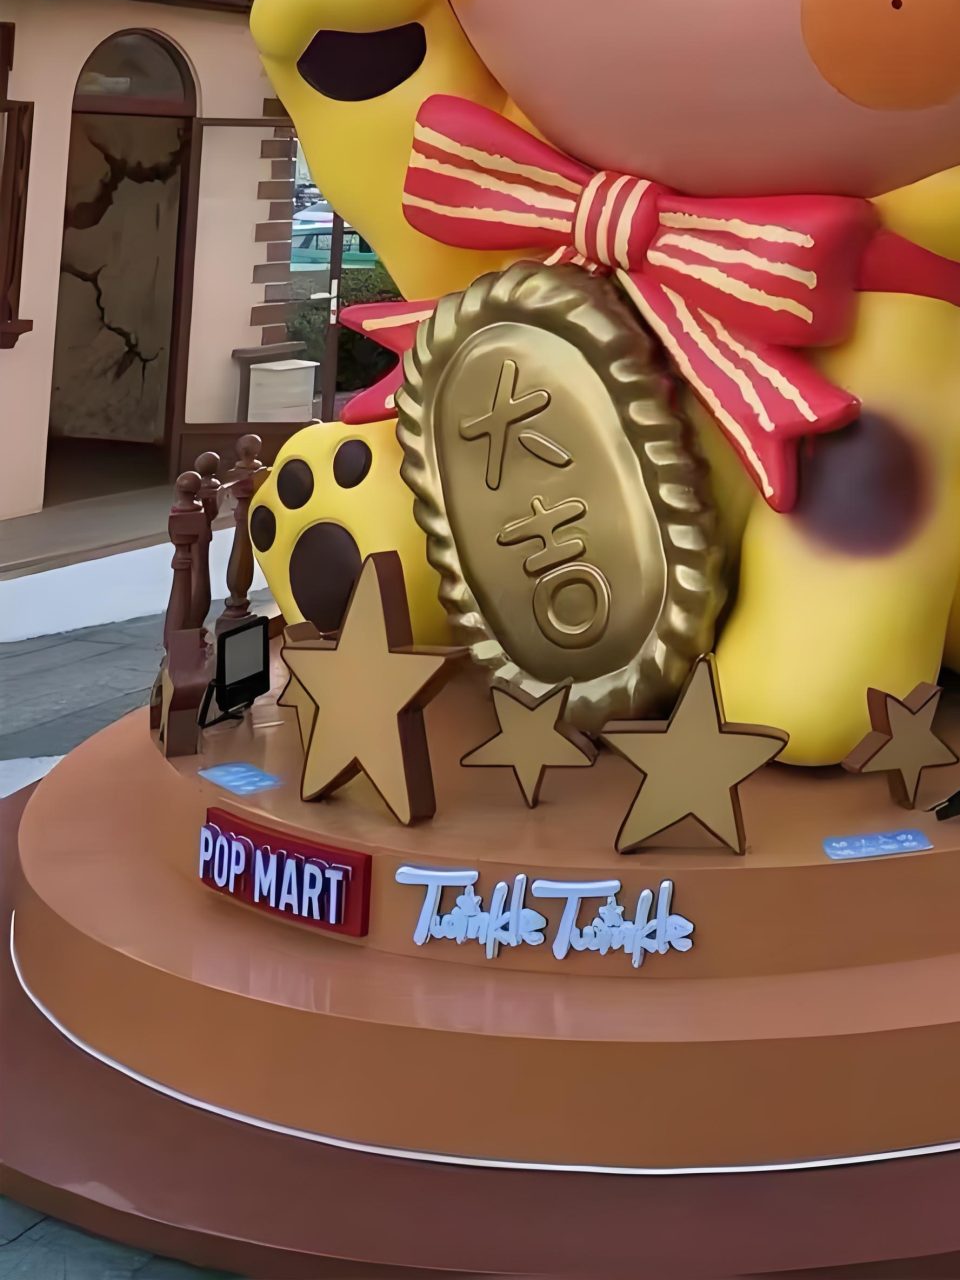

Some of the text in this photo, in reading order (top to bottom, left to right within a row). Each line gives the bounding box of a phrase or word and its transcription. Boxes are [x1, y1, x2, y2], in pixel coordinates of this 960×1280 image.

[461, 359, 610, 649] 大吉
[198, 827, 345, 924] POP MART
[395, 866, 696, 968] Twinkle Twinkle
